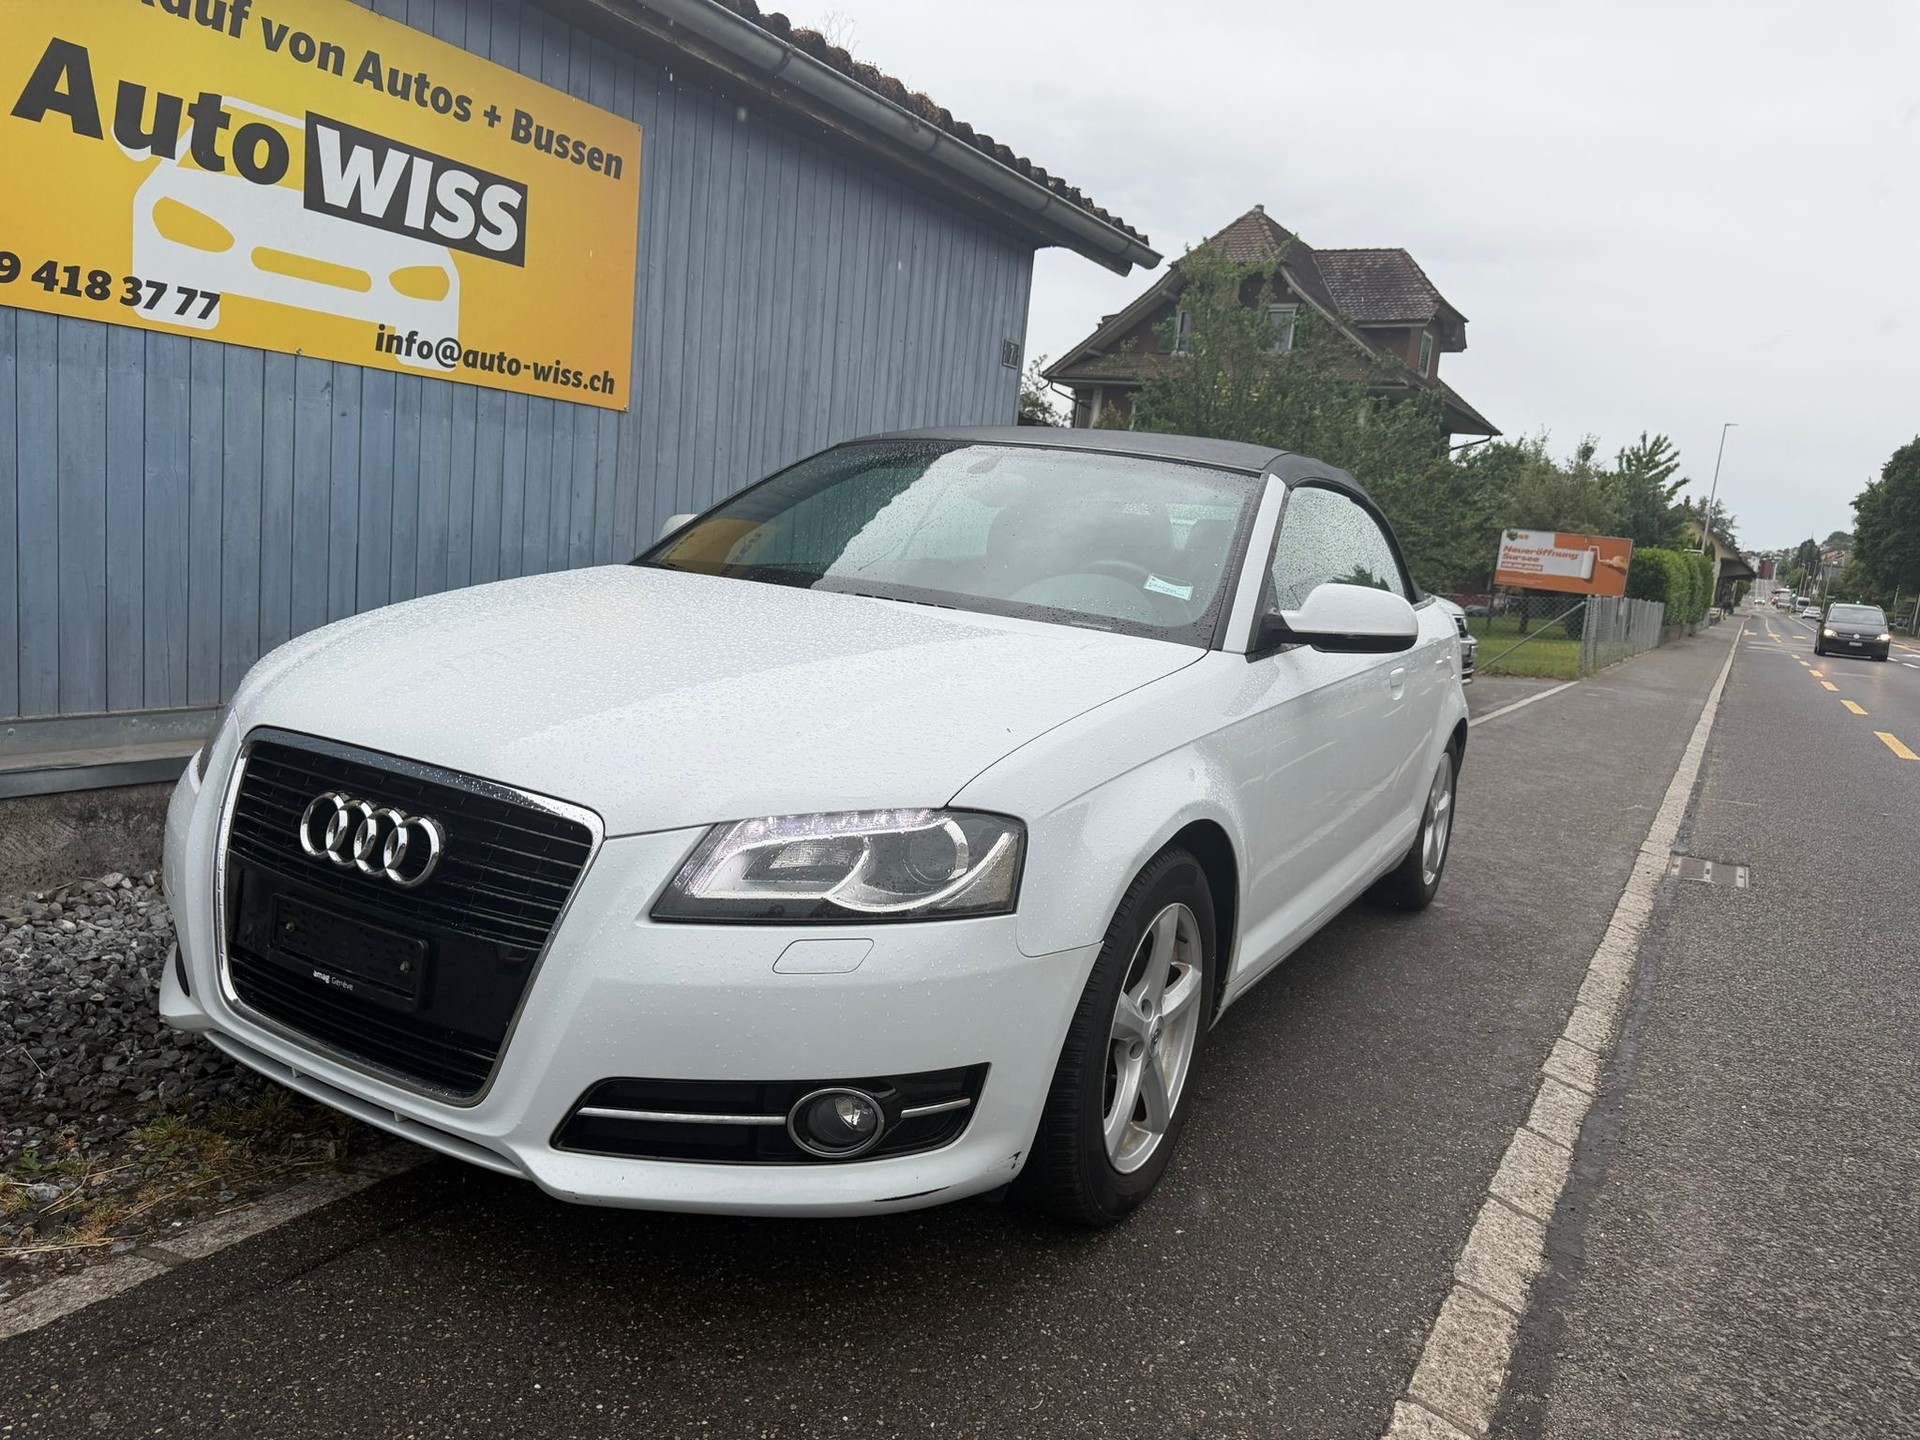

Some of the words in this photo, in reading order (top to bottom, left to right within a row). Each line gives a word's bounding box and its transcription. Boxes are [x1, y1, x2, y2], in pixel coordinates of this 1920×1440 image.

[141, 0, 252, 39] auf
[261, 16, 346, 76] von
[354, 50, 473, 123] Autos
[483, 104, 502, 129] +
[510, 108, 624, 181] Bussen
[10, 36, 290, 187] Auto
[315, 123, 525, 253] WISS
[31, 259, 112, 301] 418
[120, 276, 168, 310] 37
[175, 286, 220, 320] 77
[374, 323, 616, 395] info@auto-wiss.ch
[1502, 552, 1540, 563] Sursee
[1503, 544, 1579, 561] Neueröffnung
